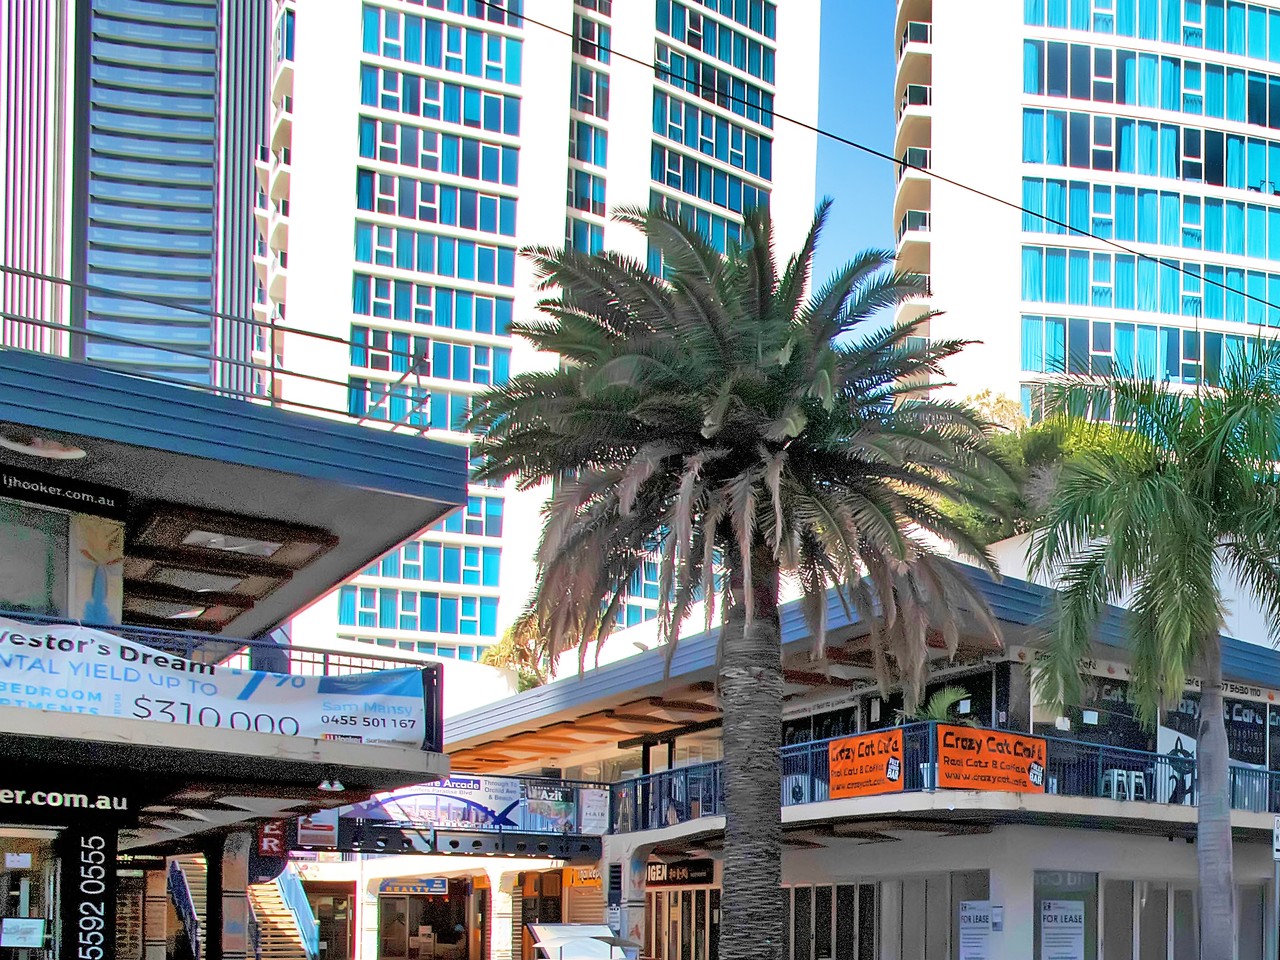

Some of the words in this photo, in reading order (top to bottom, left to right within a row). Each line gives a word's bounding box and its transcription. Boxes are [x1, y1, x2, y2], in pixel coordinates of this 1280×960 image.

[2, 473, 115, 507] ljhooker.com.au
[119, 644, 216, 675] Dream
[69, 660, 141, 682] YIELD
[148, 672, 180, 688] UP
[188, 678, 217, 696] TO
[1230, 684, 1249, 695] 5630
[322, 701, 358, 711] Sam
[363, 702, 413, 716] Mansy
[321, 715, 357, 726] 0455
[362, 717, 386, 728] 501
[391, 718, 416, 729] 167
[857, 740, 875, 758] Cat
[943, 731, 982, 754] Crazy
[986, 736, 1012, 755] Cat
[943, 756, 963, 766] Real
[966, 758, 989, 768] Cats
[1000, 761, 1027, 774] Coffee
[886, 769, 899, 781] BAR
[1029, 772, 1043, 785] BAR
[443, 779, 480, 790] Arcade
[484, 779, 508, 787] Through
[0, 789, 128, 811] er.com.au
[540, 789, 563, 802] Azit
[79, 836, 106, 895] 0555
[960, 914, 972, 924] FOR
[973, 914, 989, 924] LEASE
[1042, 914, 1059, 923] FOR
[1060, 914, 1082, 923] LEASE
[78, 902, 105, 960] 5592
